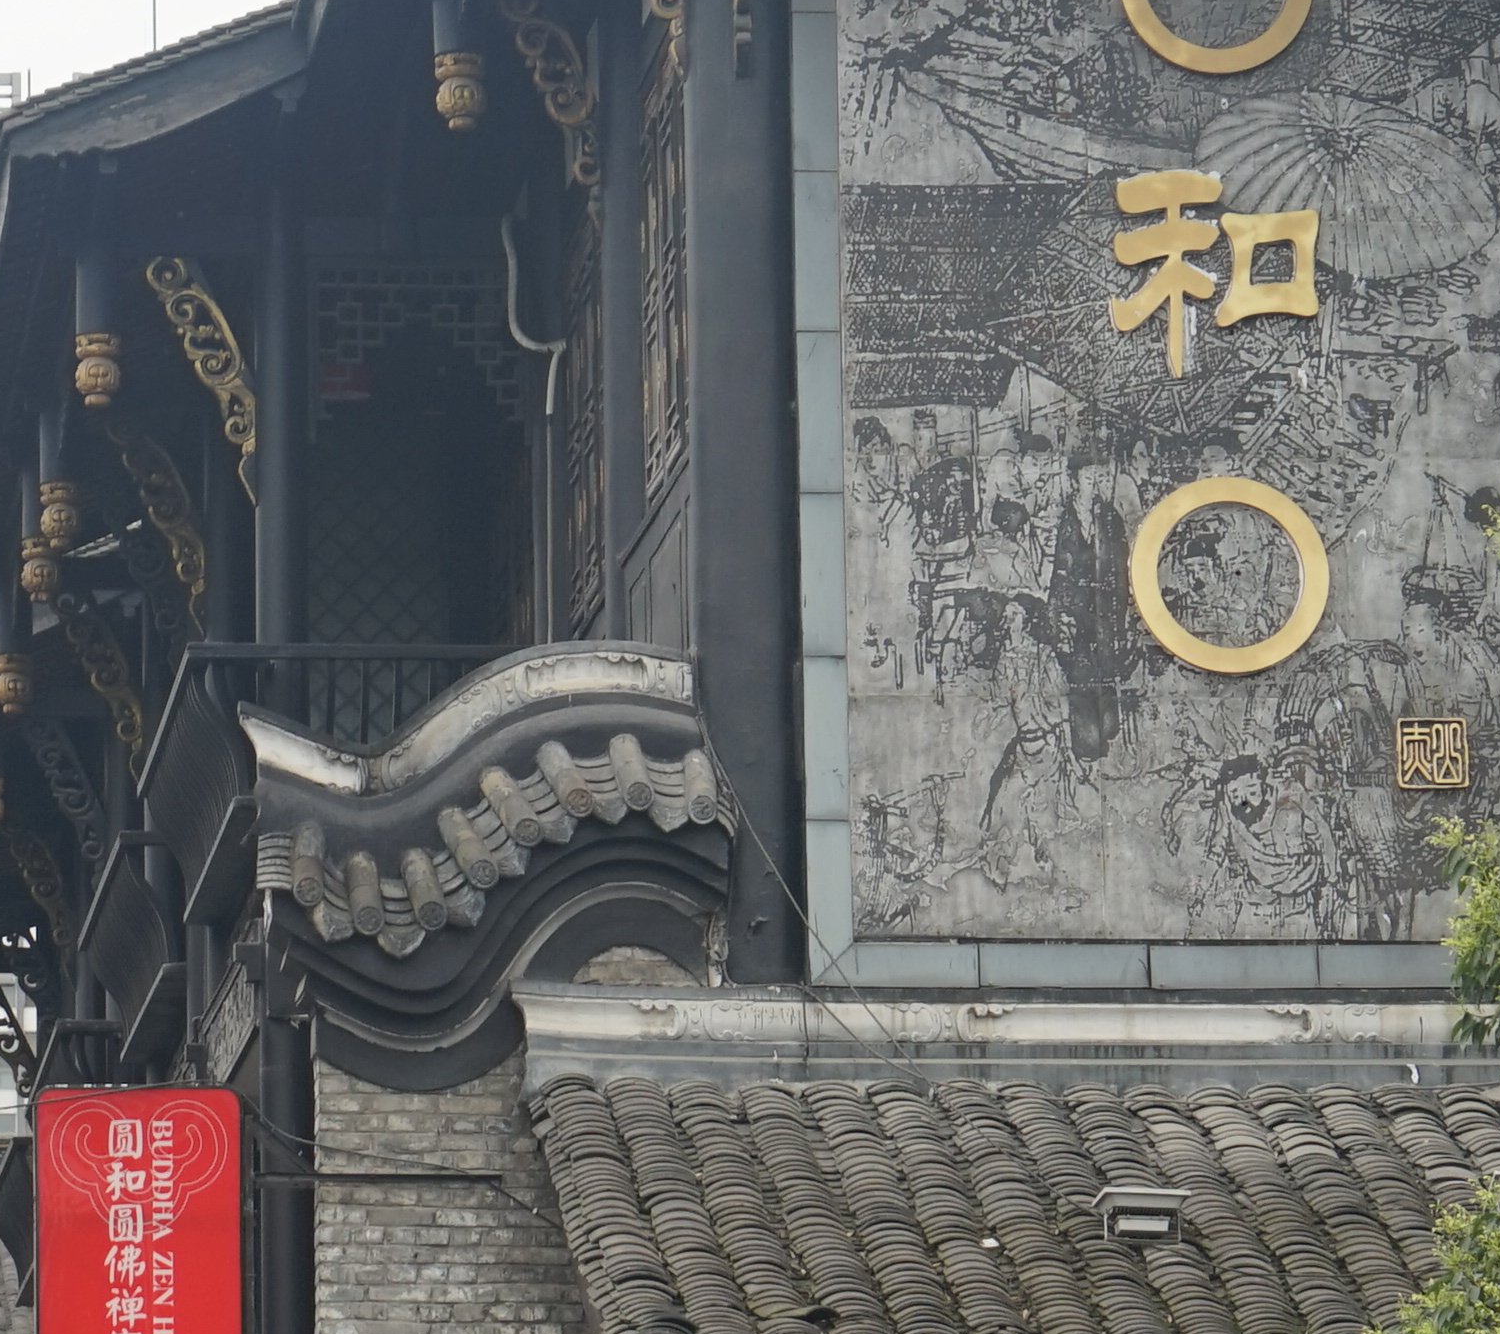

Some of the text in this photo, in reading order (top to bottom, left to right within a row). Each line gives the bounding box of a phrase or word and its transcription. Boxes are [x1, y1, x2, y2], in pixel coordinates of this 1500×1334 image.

[1109, 170, 1320, 378] 和
[152, 1120, 174, 1241] BUDDHA
[152, 1251, 174, 1306] ZEN
